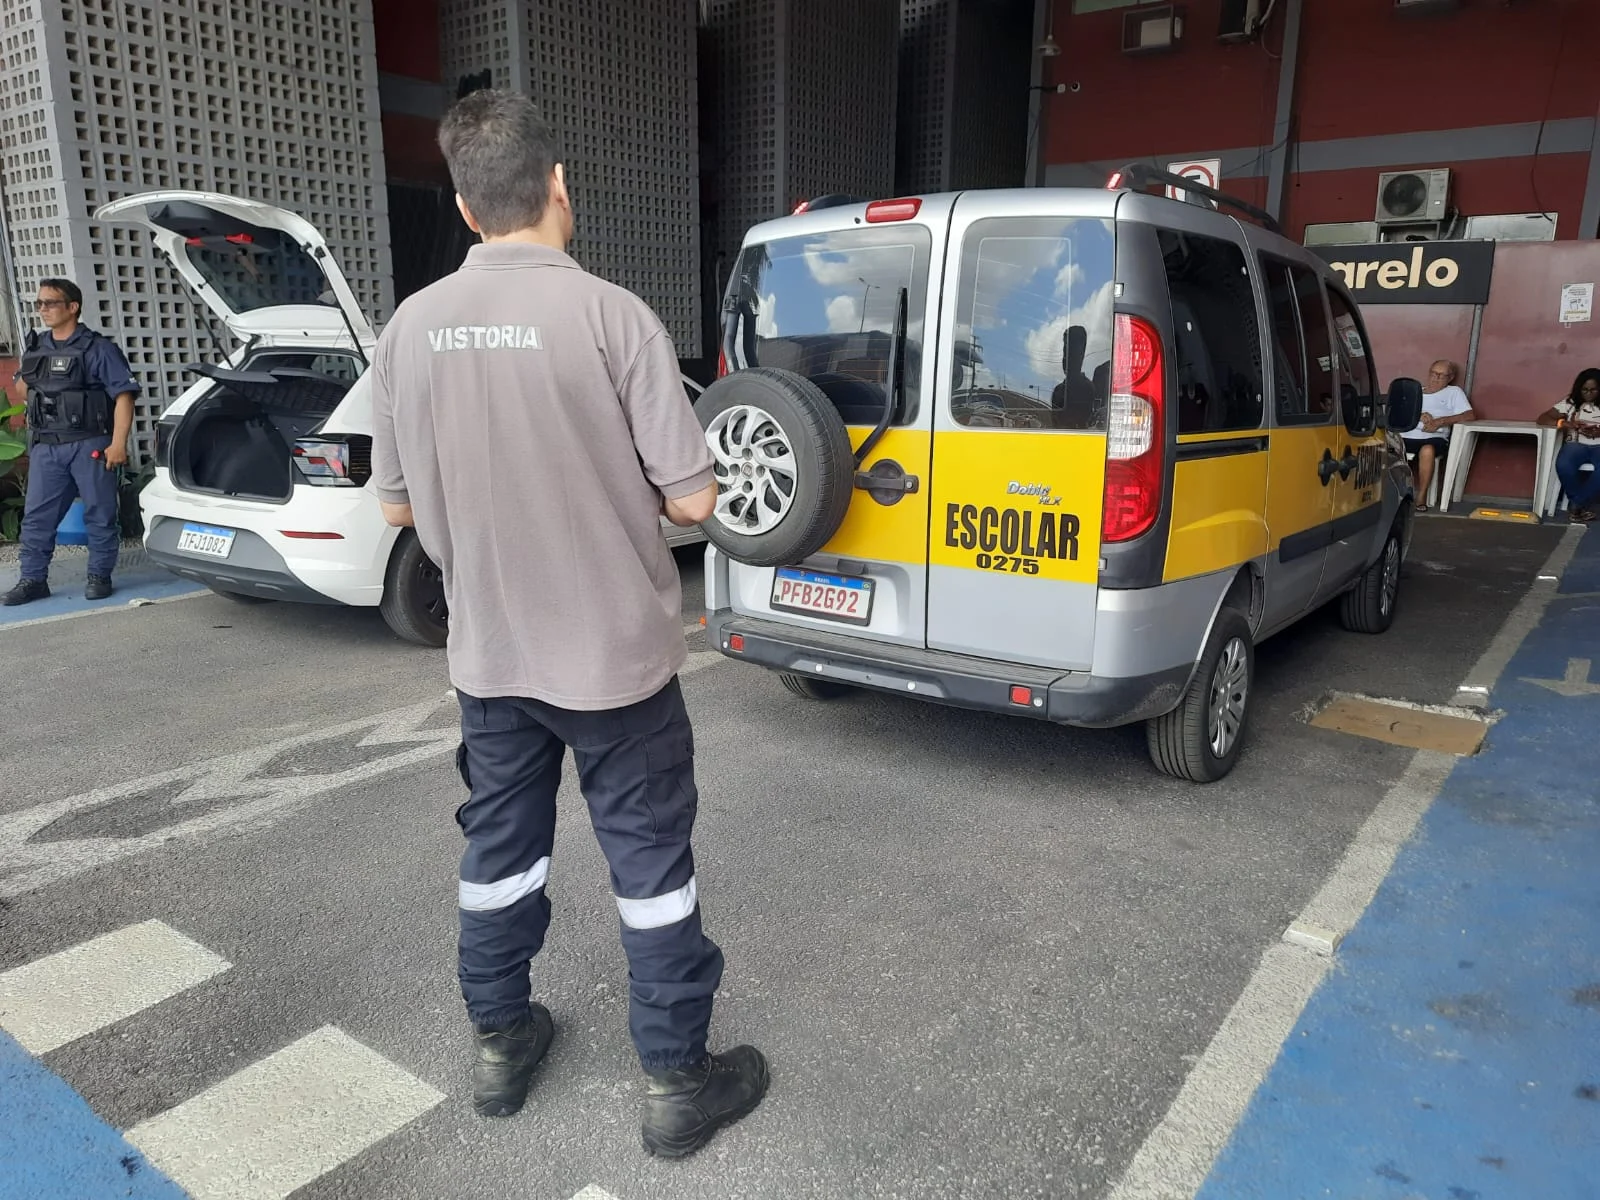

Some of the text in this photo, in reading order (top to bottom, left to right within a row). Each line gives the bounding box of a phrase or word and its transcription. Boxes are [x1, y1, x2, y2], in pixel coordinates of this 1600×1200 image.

[427, 325, 544, 352] VISTORIA
[183, 532, 226, 554] TFJ1D82
[945, 502, 1080, 561] ESCOLAR
[976, 553, 1040, 575] 0275
[781, 580, 859, 613] PFB2G92
